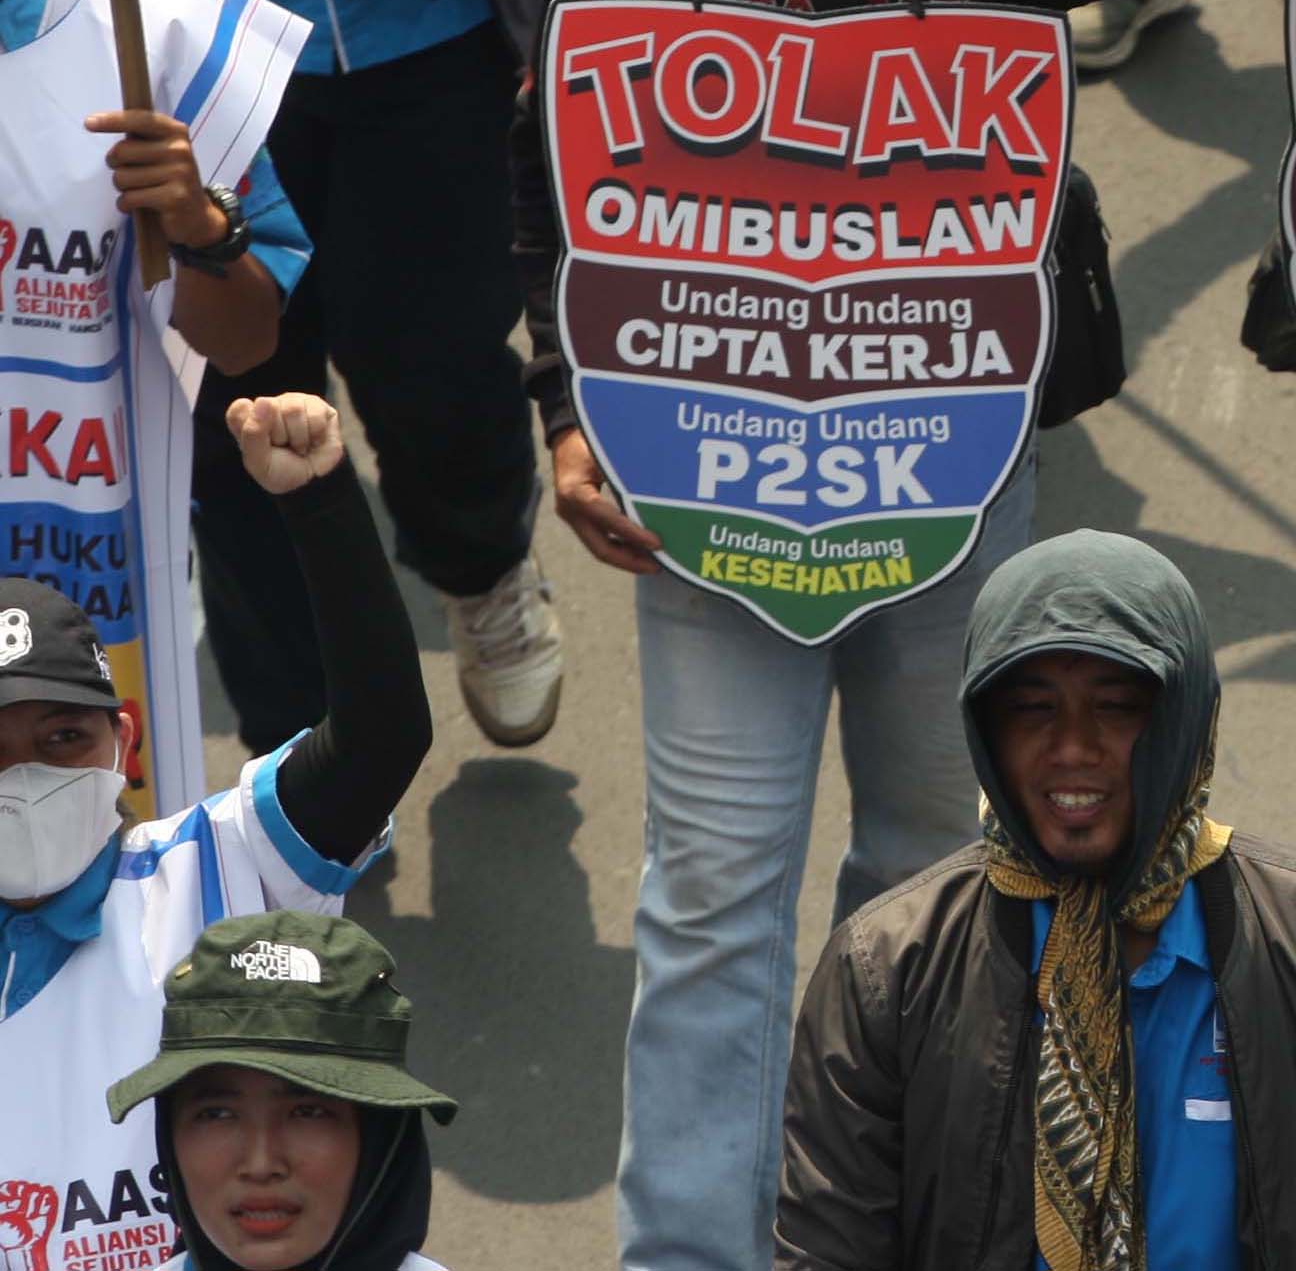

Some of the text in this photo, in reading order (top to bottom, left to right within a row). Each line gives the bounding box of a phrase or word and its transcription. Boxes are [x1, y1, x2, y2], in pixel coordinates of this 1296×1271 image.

[563, 28, 1055, 169] TOLAK
[585, 185, 1037, 262] OMIBUSLAW
[16, 297, 93, 320] SEJUTA
[660, 281, 973, 328] Undang Undang
[615, 319, 1014, 381] CIPTA KERJA
[677, 403, 951, 445] Undang Undang
[697, 439, 934, 507] P2SK
[709, 524, 906, 561] Undang Undang
[700, 550, 914, 597] KESEHATAN
[231, 952, 290, 970] NORTH
[256, 940, 289, 955] THE
[246, 965, 290, 981] FACE
[64, 1223, 167, 1260] ALIANSI
